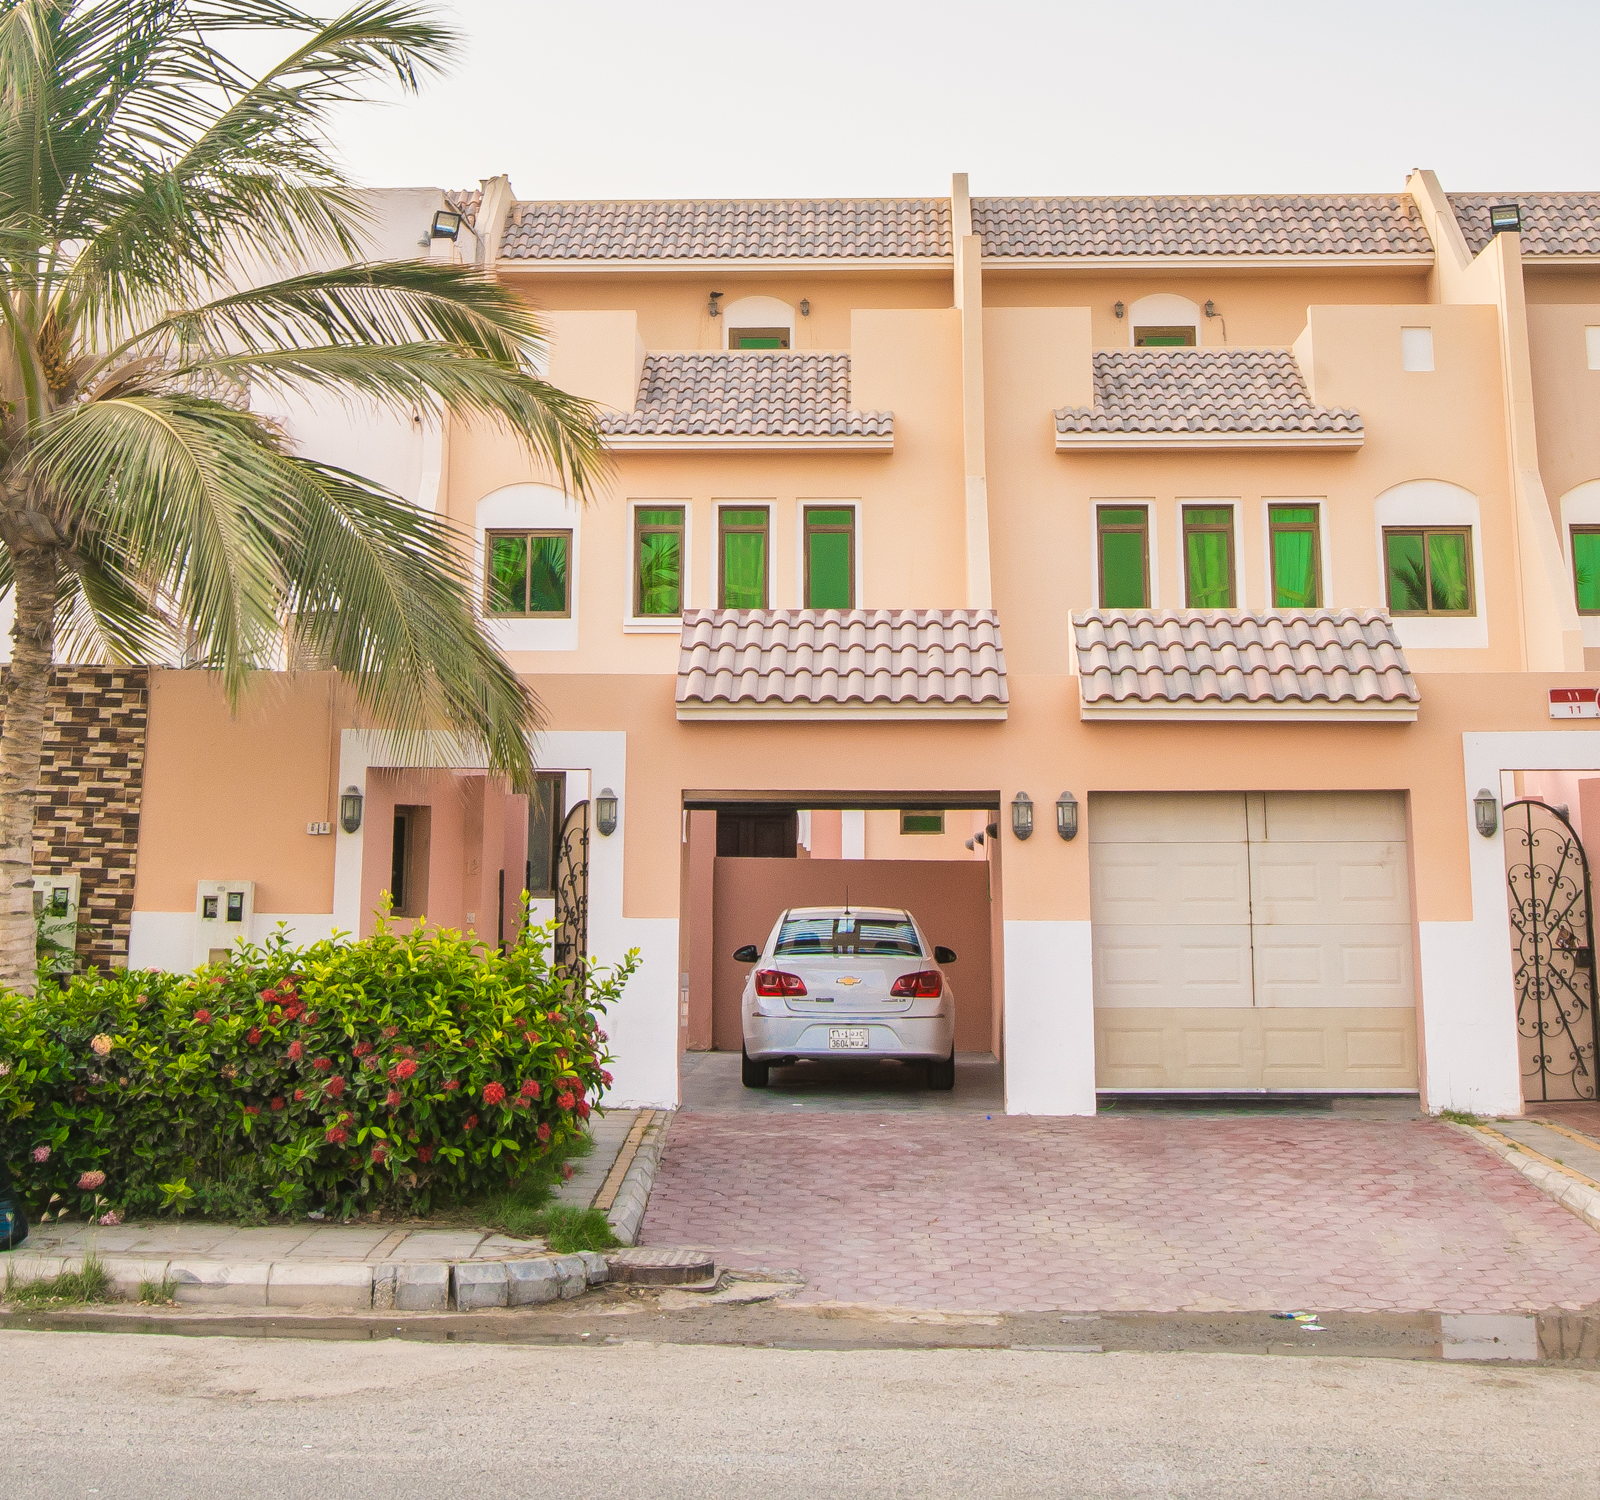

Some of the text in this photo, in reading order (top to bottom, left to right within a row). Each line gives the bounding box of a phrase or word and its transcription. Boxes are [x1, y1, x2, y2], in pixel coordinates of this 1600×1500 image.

[1567, 691, 1580, 701] ١١
[1568, 705, 1582, 714] 11
[831, 1039, 849, 1048] 3604
